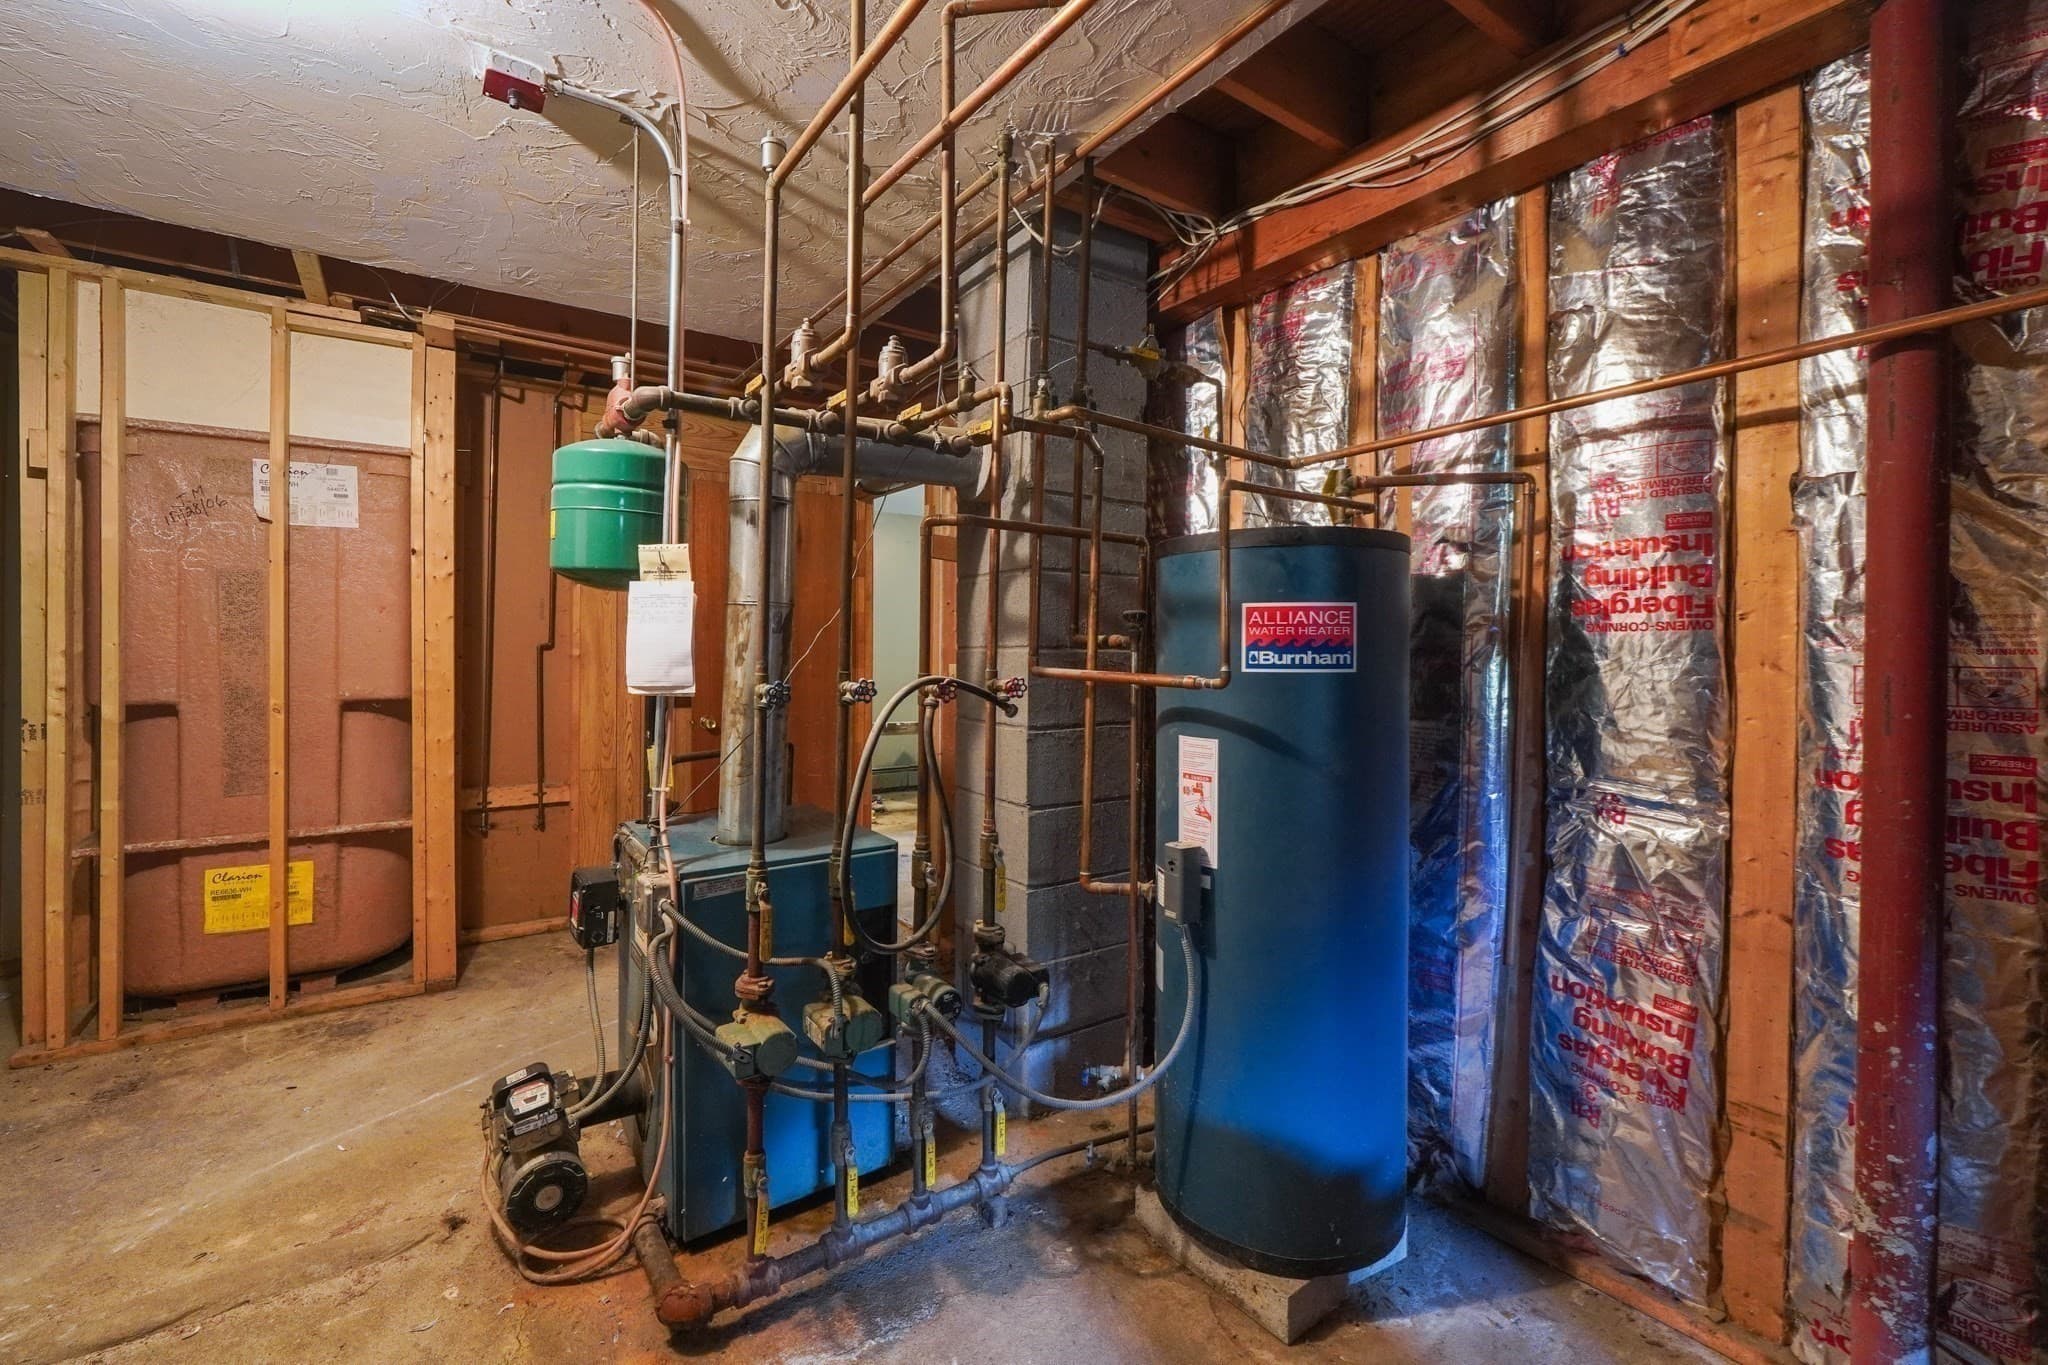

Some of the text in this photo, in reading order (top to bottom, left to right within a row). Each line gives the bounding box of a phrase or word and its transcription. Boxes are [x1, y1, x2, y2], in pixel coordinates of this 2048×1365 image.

[1649, 484, 1713, 499] ASSURED
[1562, 533, 1713, 562] Insulation
[1584, 563, 1713, 591] Building
[1571, 592, 1714, 621] Fiberglas
[1248, 610, 1351, 625] ALLIANCE
[1248, 626, 1351, 635] WATER HEATER
[1585, 619, 1714, 633] OWENS-CORNING
[1259, 650, 1351, 665] Burnham
[1945, 721, 2040, 736] ASSURED
[212, 871, 263, 884] Clarion
